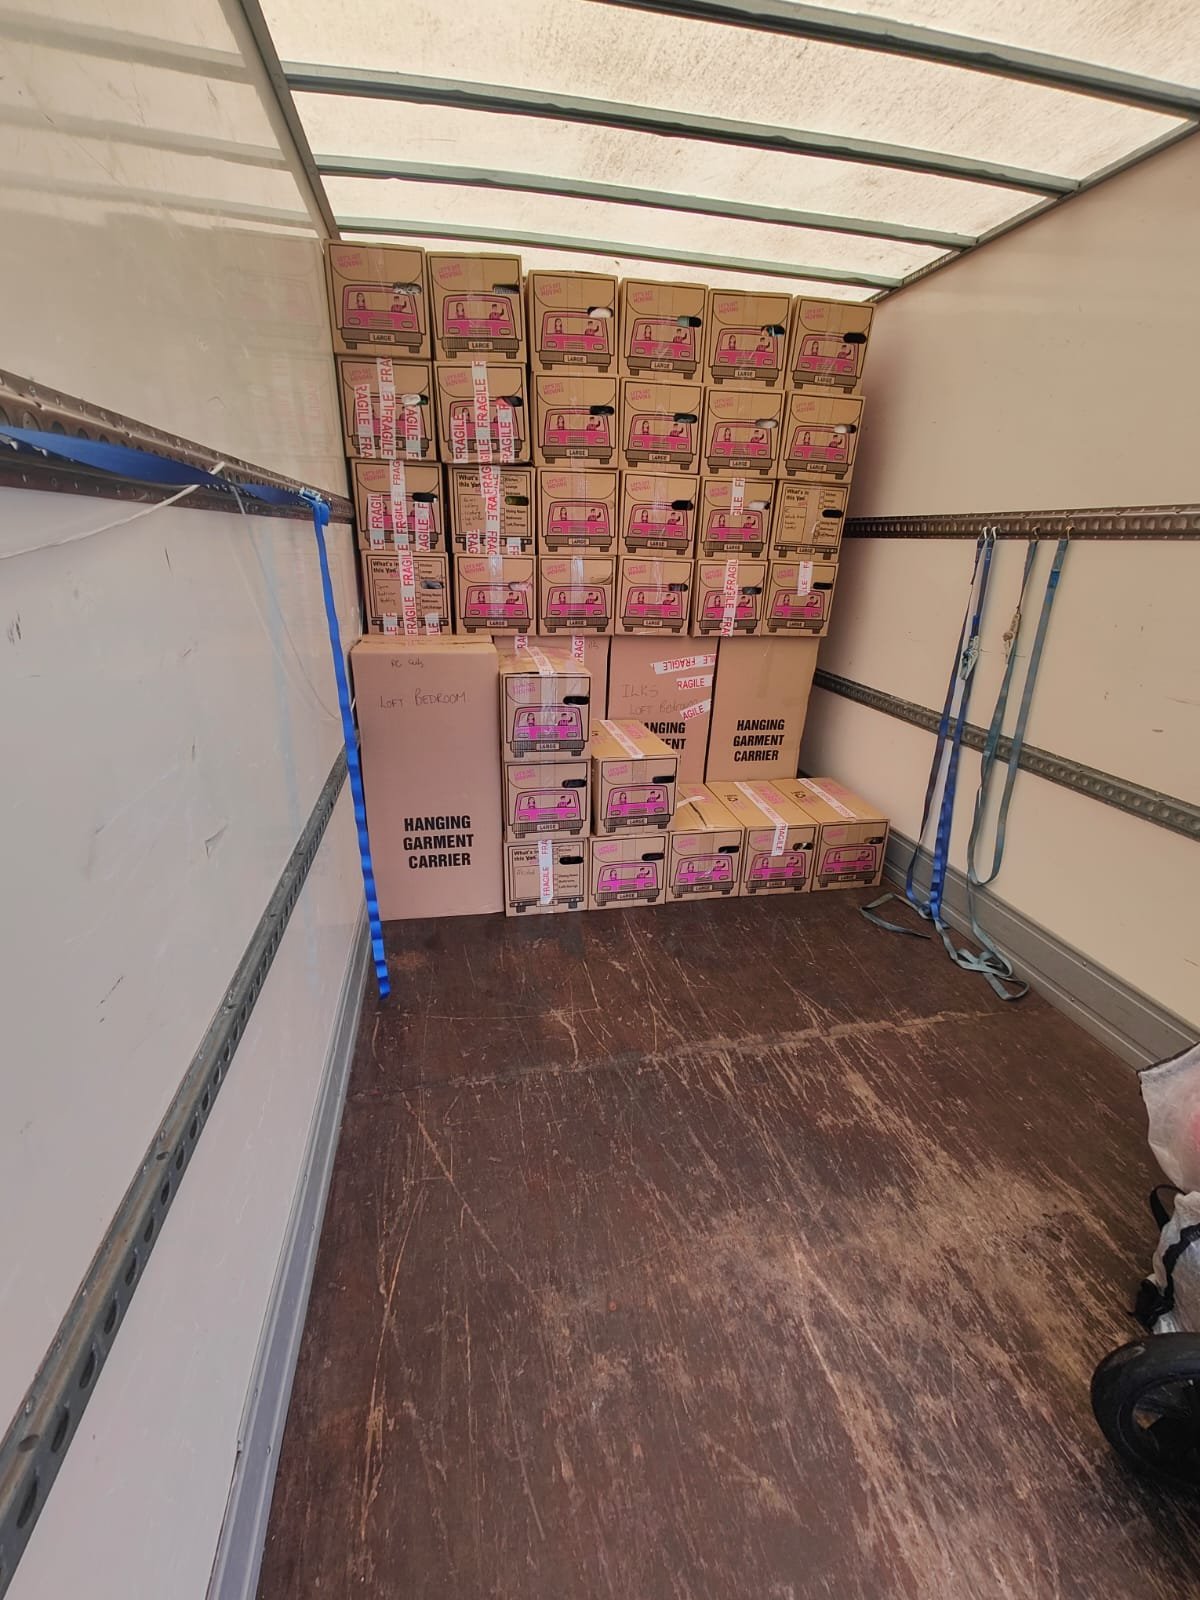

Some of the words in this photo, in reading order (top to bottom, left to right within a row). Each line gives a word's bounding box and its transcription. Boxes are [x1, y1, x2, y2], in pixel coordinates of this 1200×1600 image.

[475, 378, 488, 427] FRAGILE
[452, 414, 466, 459] FRAGILE
[501, 422, 512, 464] FRAGILE
[404, 597, 417, 634] FRAGILE
[663, 657, 696, 671] FRAGILE
[677, 678, 705, 690] RAGILE
[414, 688, 466, 706] BEDROOM
[683, 705, 704, 720] AGILE
[737, 719, 785, 731] HANGING
[733, 734, 784, 747] GARMENT
[734, 750, 779, 762] CARRIER
[404, 815, 471, 832] HANGING
[403, 834, 474, 851] GARMENT
[408, 852, 471, 869] CARRIER
[542, 866, 551, 896] FRAGILE
